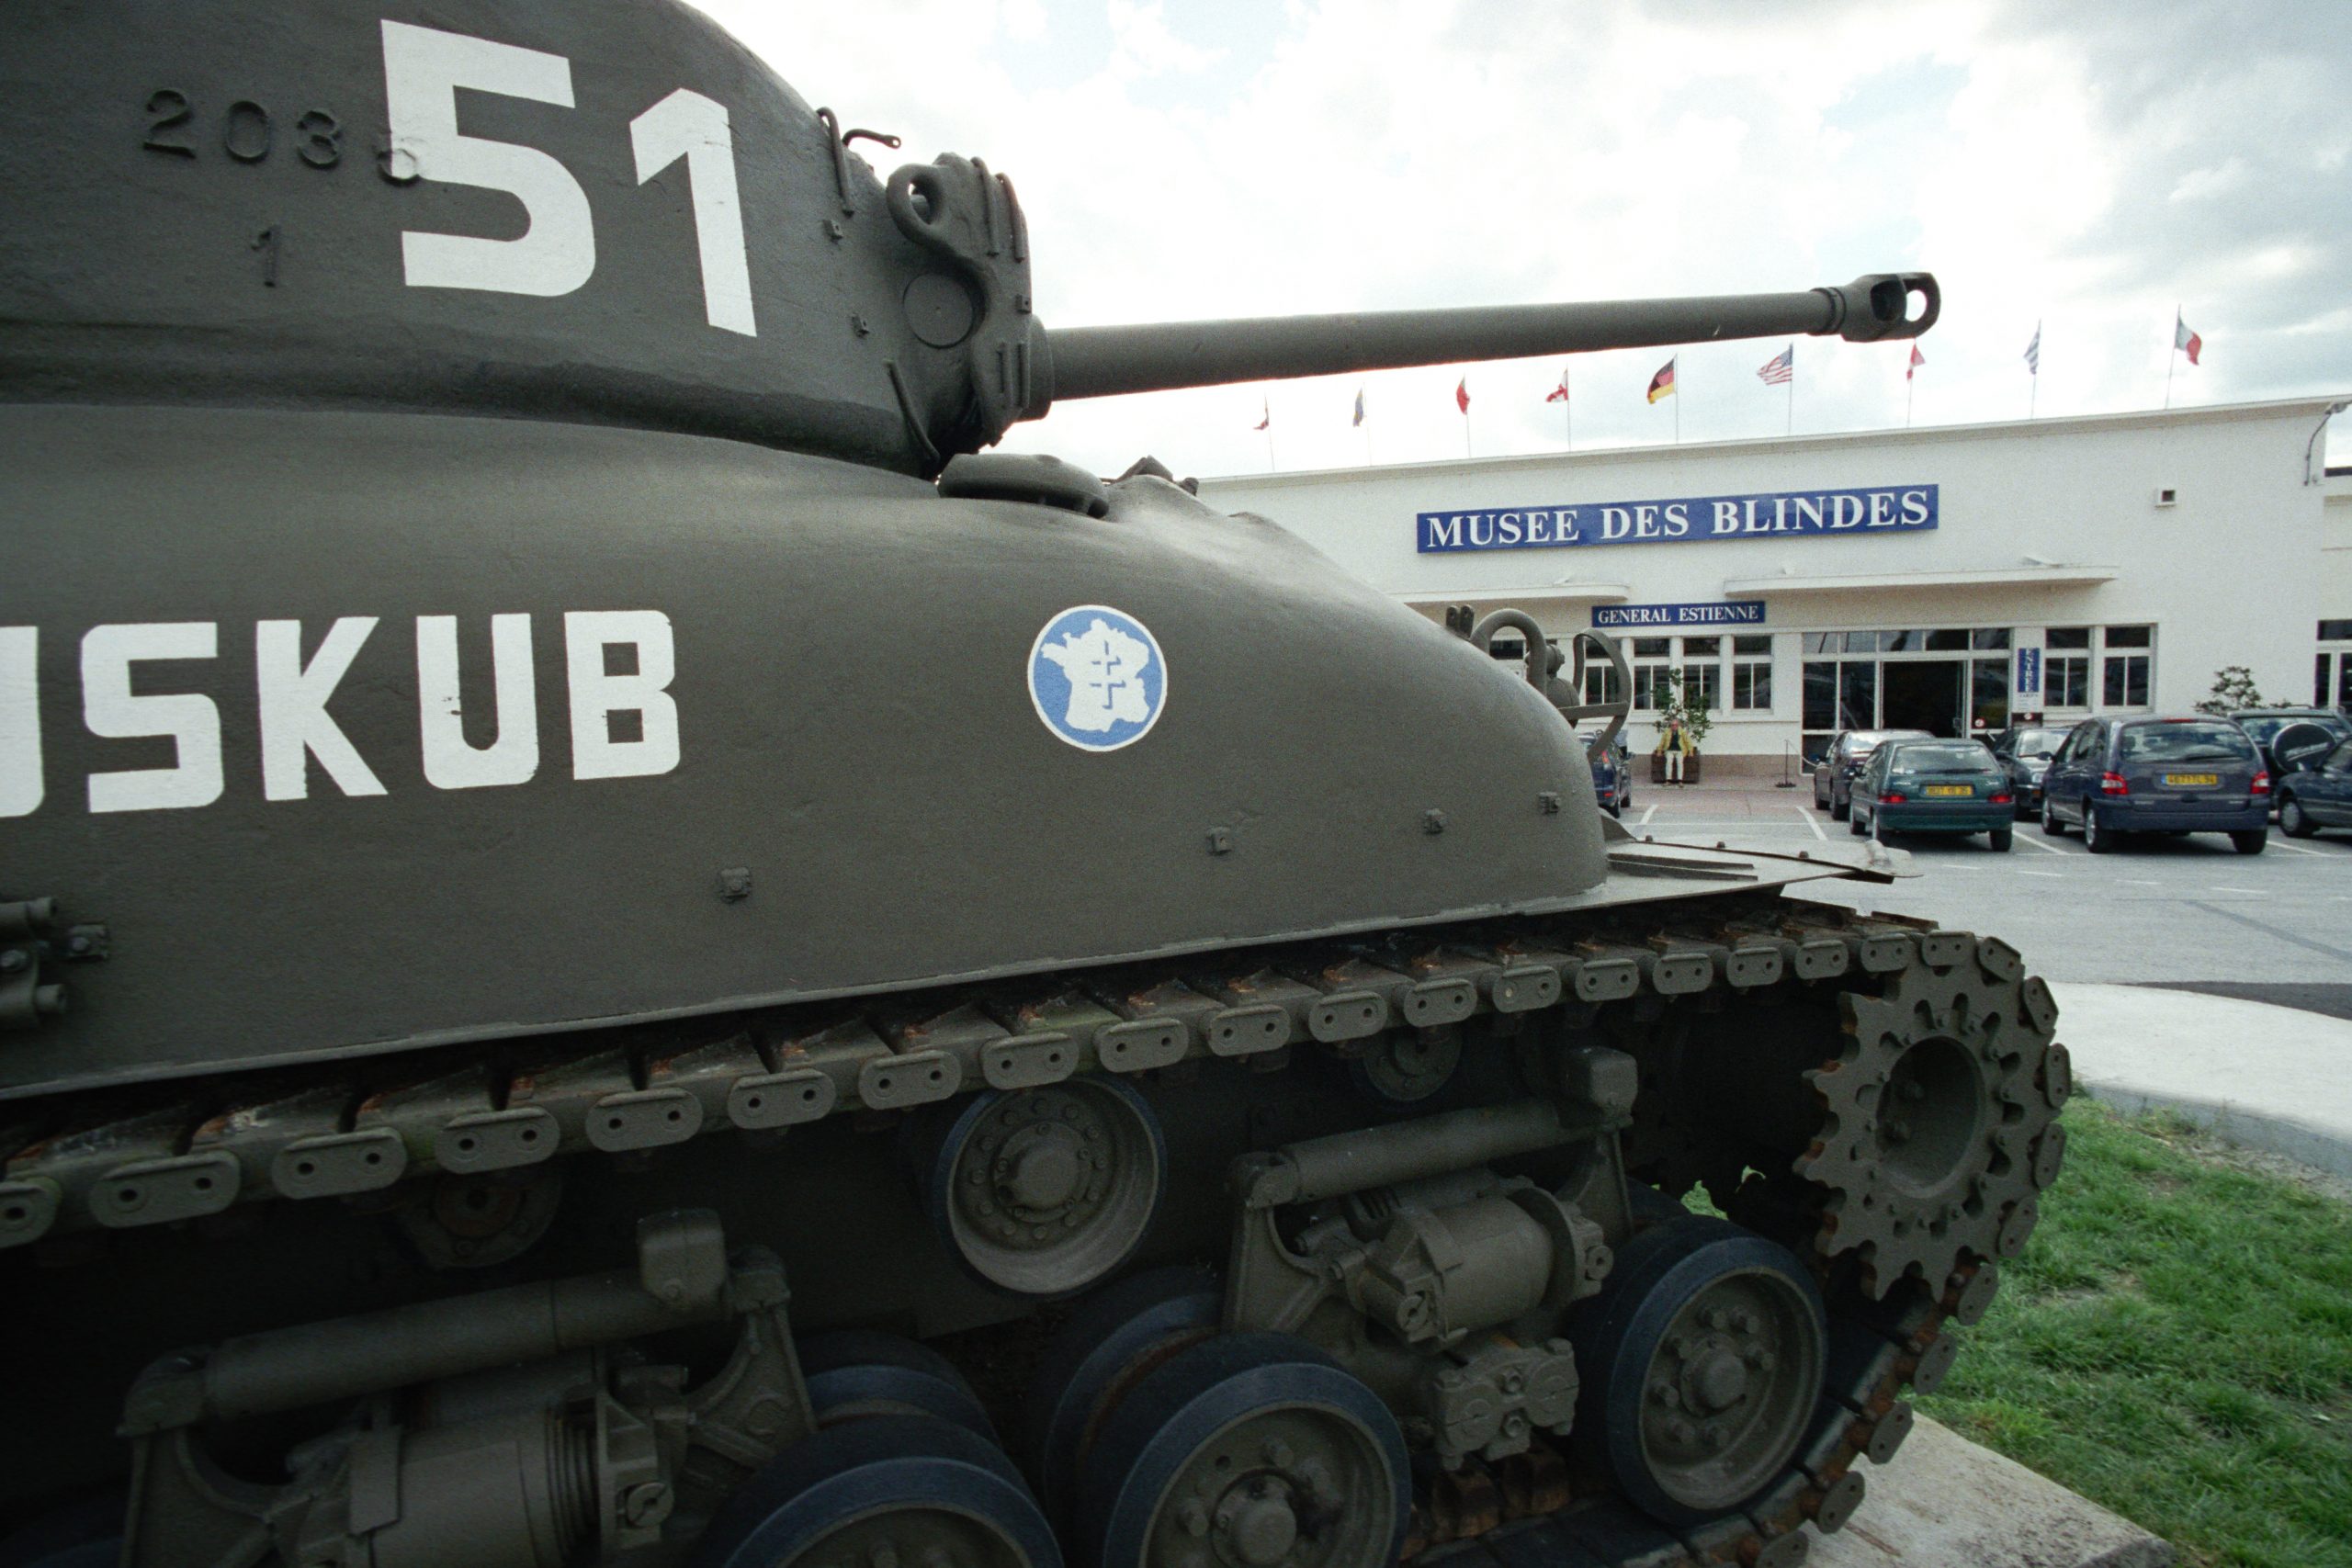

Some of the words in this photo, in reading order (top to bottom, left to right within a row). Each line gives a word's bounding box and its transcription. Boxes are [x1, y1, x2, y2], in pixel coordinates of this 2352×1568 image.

[381, 20, 757, 337] 51
[1427, 510, 1579, 547] MUSEE
[1600, 504, 1690, 540] DES
[1711, 491, 1928, 534] BLINDES
[1598, 607, 1671, 624] GENERAL
[1679, 605, 1758, 622] ESTIENNE
